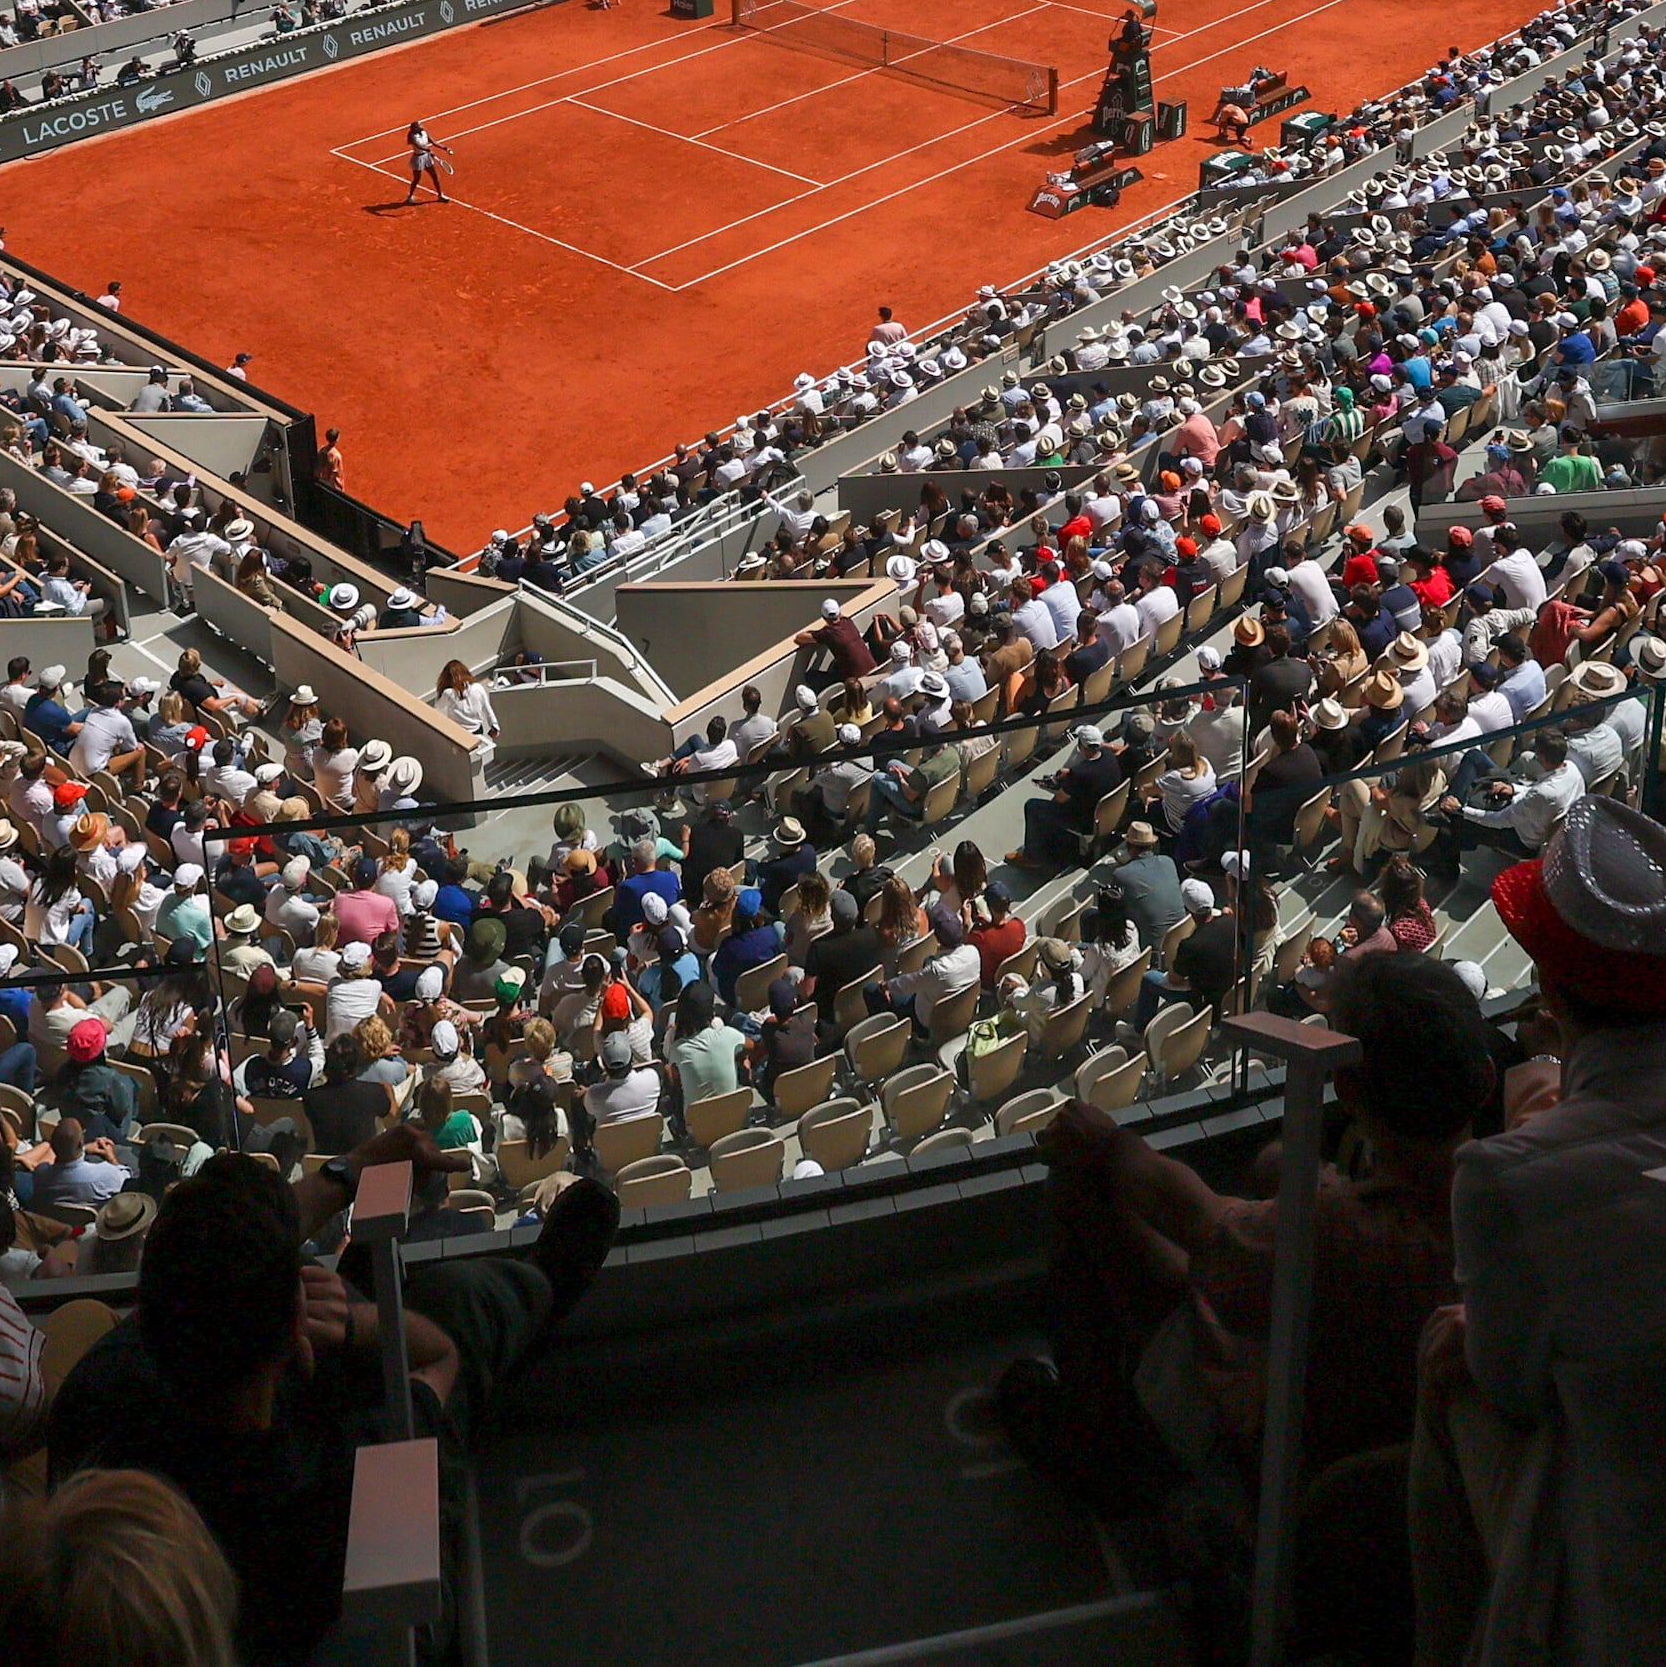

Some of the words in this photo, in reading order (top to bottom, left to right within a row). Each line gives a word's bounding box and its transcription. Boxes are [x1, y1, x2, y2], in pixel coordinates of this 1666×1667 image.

[350, 12, 426, 46] RENAULT
[224, 47, 308, 82] RENAULT
[22, 100, 127, 144] LACOSTE
[1033, 191, 1061, 208] Perrier
